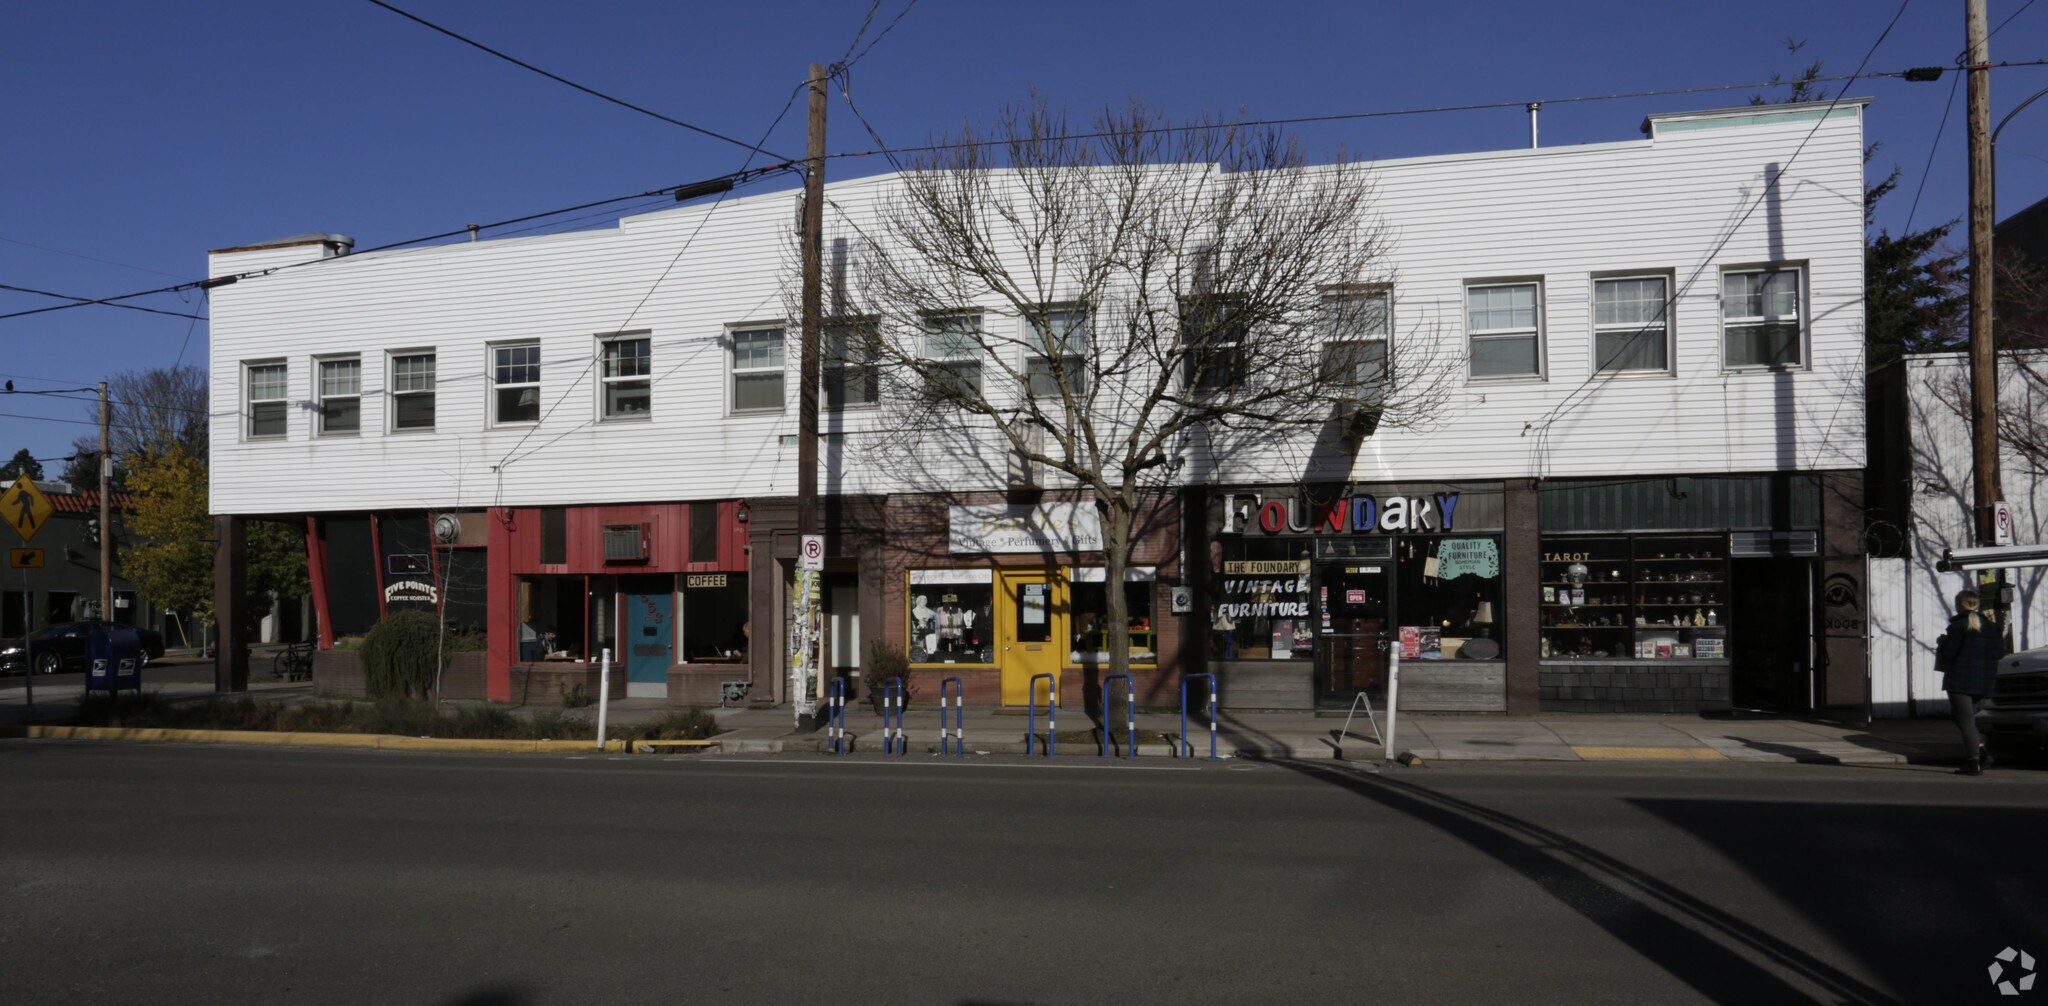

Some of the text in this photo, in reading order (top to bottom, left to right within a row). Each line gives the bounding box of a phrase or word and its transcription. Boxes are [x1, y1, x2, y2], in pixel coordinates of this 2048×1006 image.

[957, 534, 1098, 549] Vintage Perfumery Gifts
[1451, 541, 1482, 550] QUALITY
[1448, 551, 1488, 560] FURNITURE
[1544, 552, 1590, 561] TAROT
[1228, 562, 1300, 573] THE FOUNDARY
[688, 575, 726, 587] COFFEE
[1224, 579, 1308, 594] VINTAGE
[385, 580, 438, 604] FIVE POINTS
[1217, 601, 1310, 618] FURNITURE
